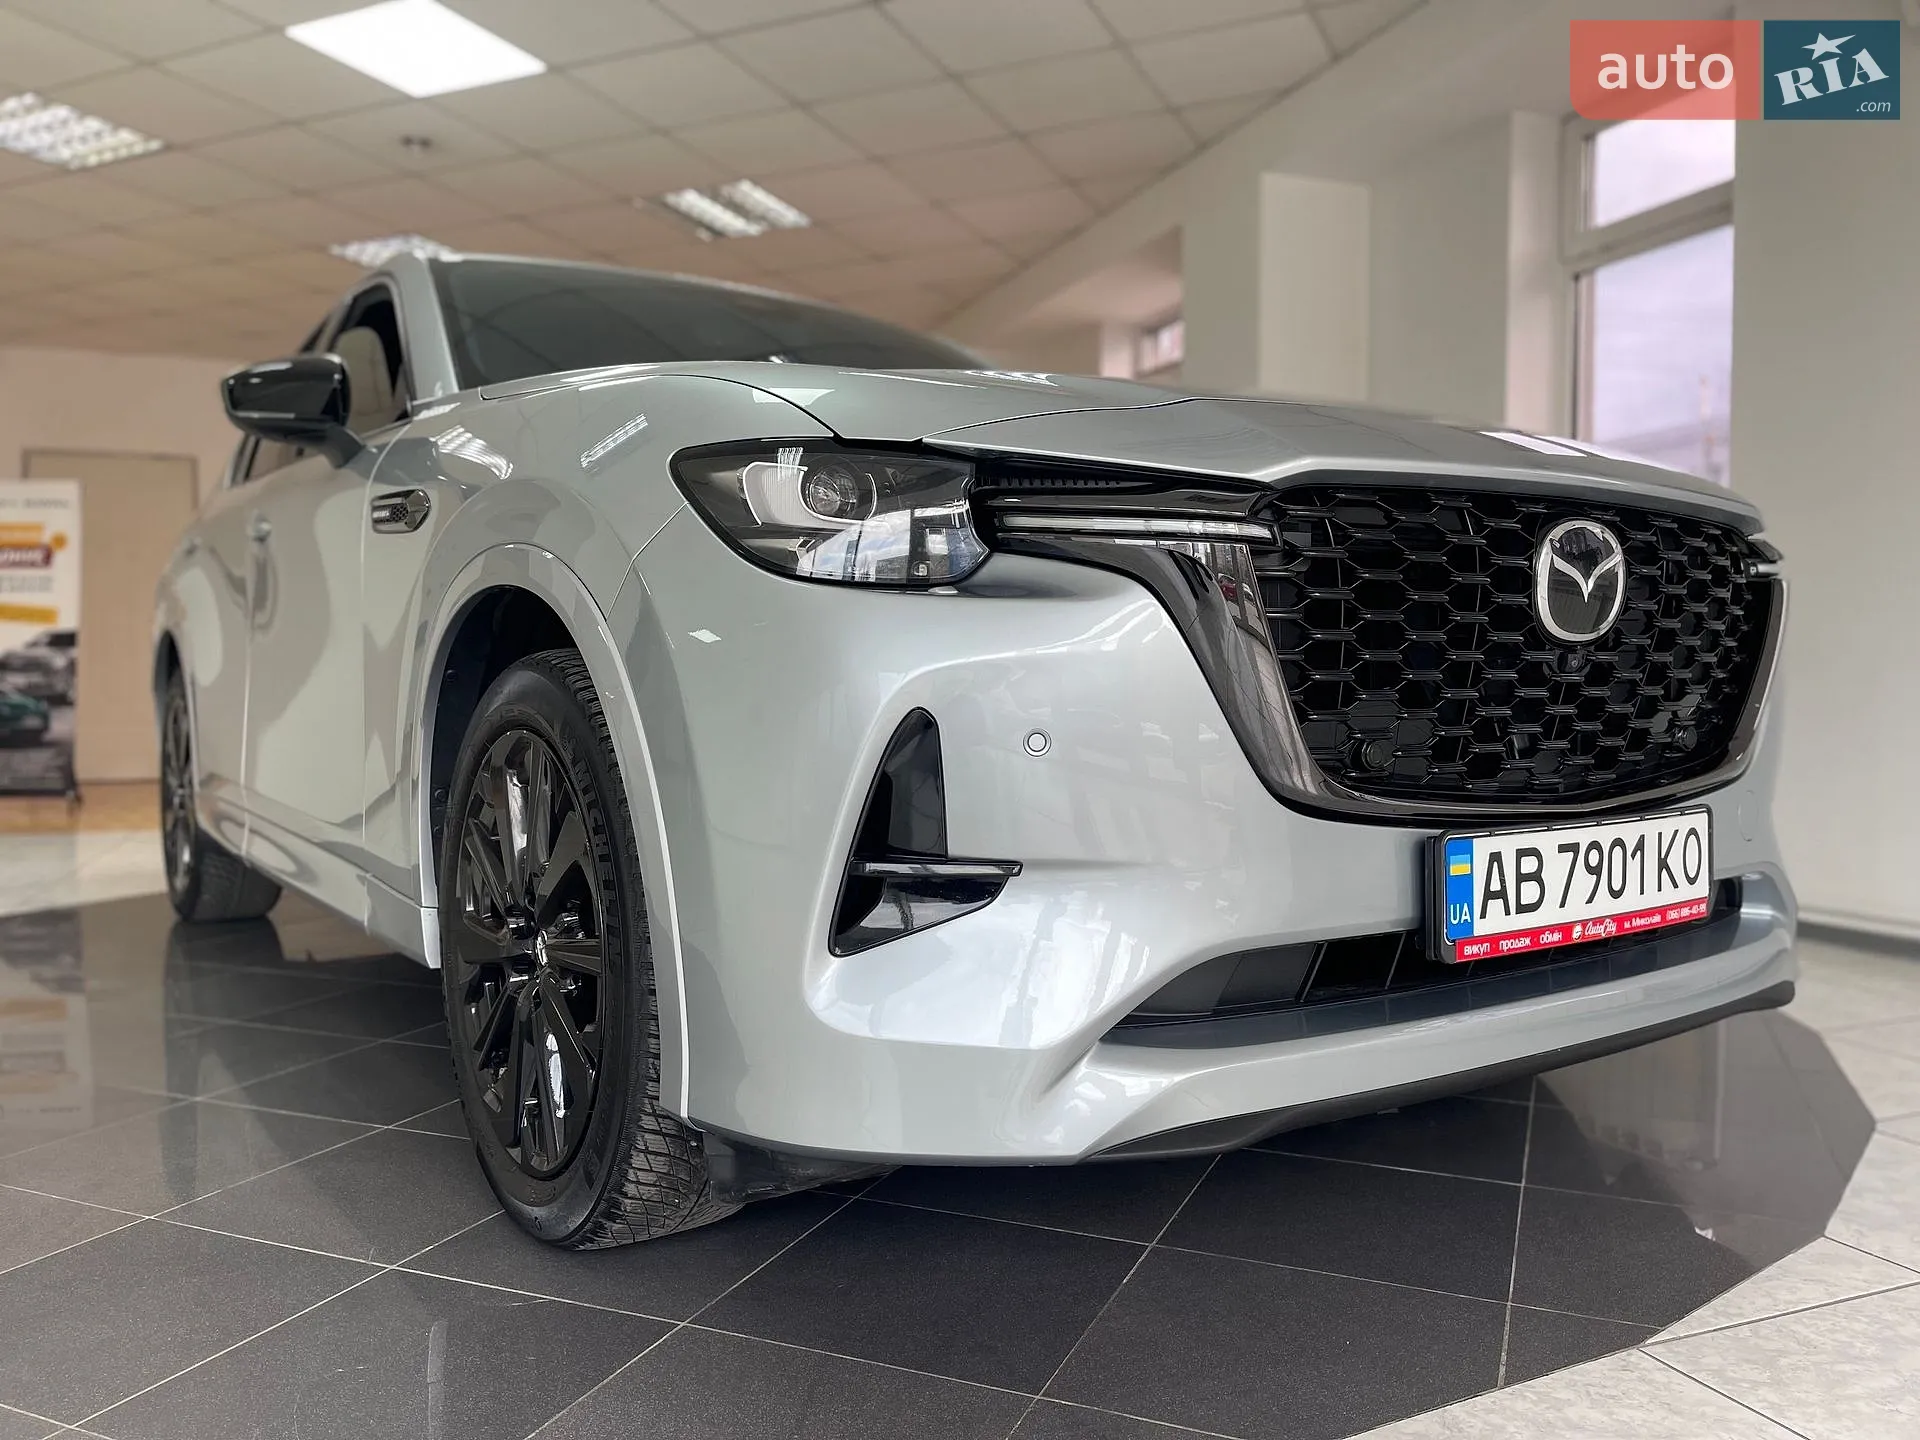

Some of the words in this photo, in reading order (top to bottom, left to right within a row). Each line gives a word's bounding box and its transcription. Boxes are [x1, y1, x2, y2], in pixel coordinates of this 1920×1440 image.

[1479, 847, 1546, 920] AB
[1557, 833, 1646, 909] 7901
[1657, 826, 1702, 893] KO
[1450, 903, 1472, 925] UA
[1464, 943, 1490, 956] викуп
[1499, 936, 1532, 952] продаж
[1540, 930, 1563, 944] обмін
